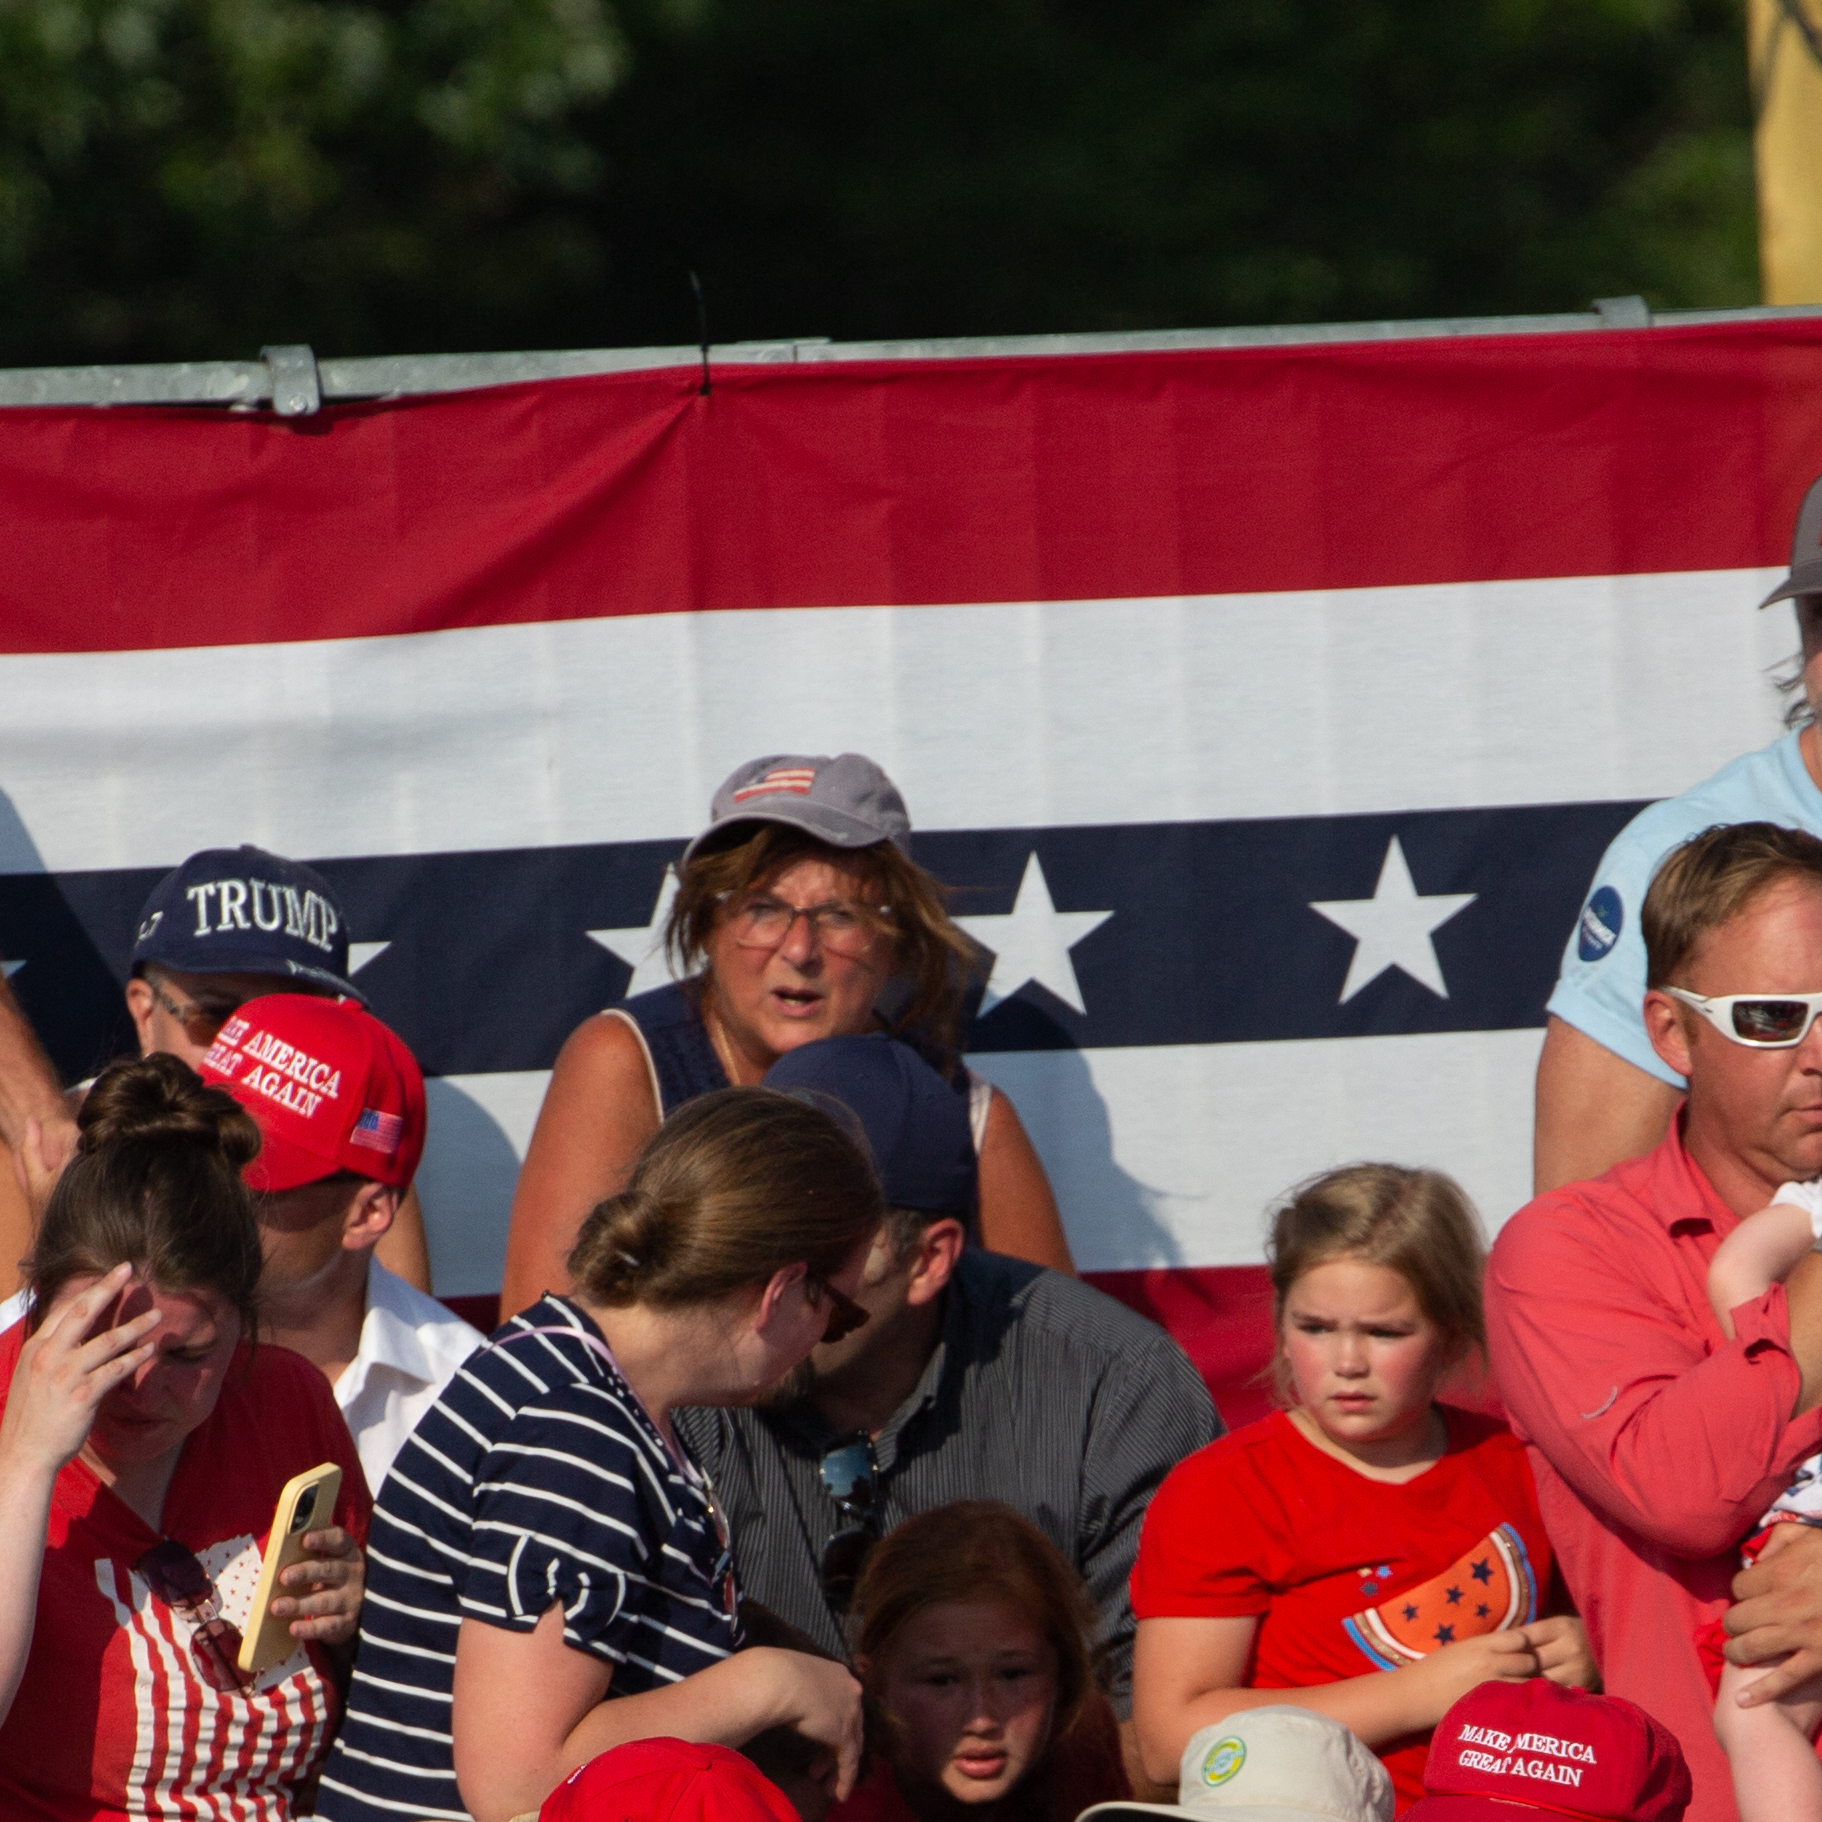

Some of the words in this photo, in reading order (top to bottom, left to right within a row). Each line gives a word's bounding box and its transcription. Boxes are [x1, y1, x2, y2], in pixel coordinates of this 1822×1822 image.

[185, 877, 339, 952] TRUMP
[241, 1064, 322, 1119] AGAIN
[242, 1030, 342, 1099] AMERICA
[1458, 1724, 1510, 1753] MAKE
[1510, 1752, 1583, 1787] AGAIN
